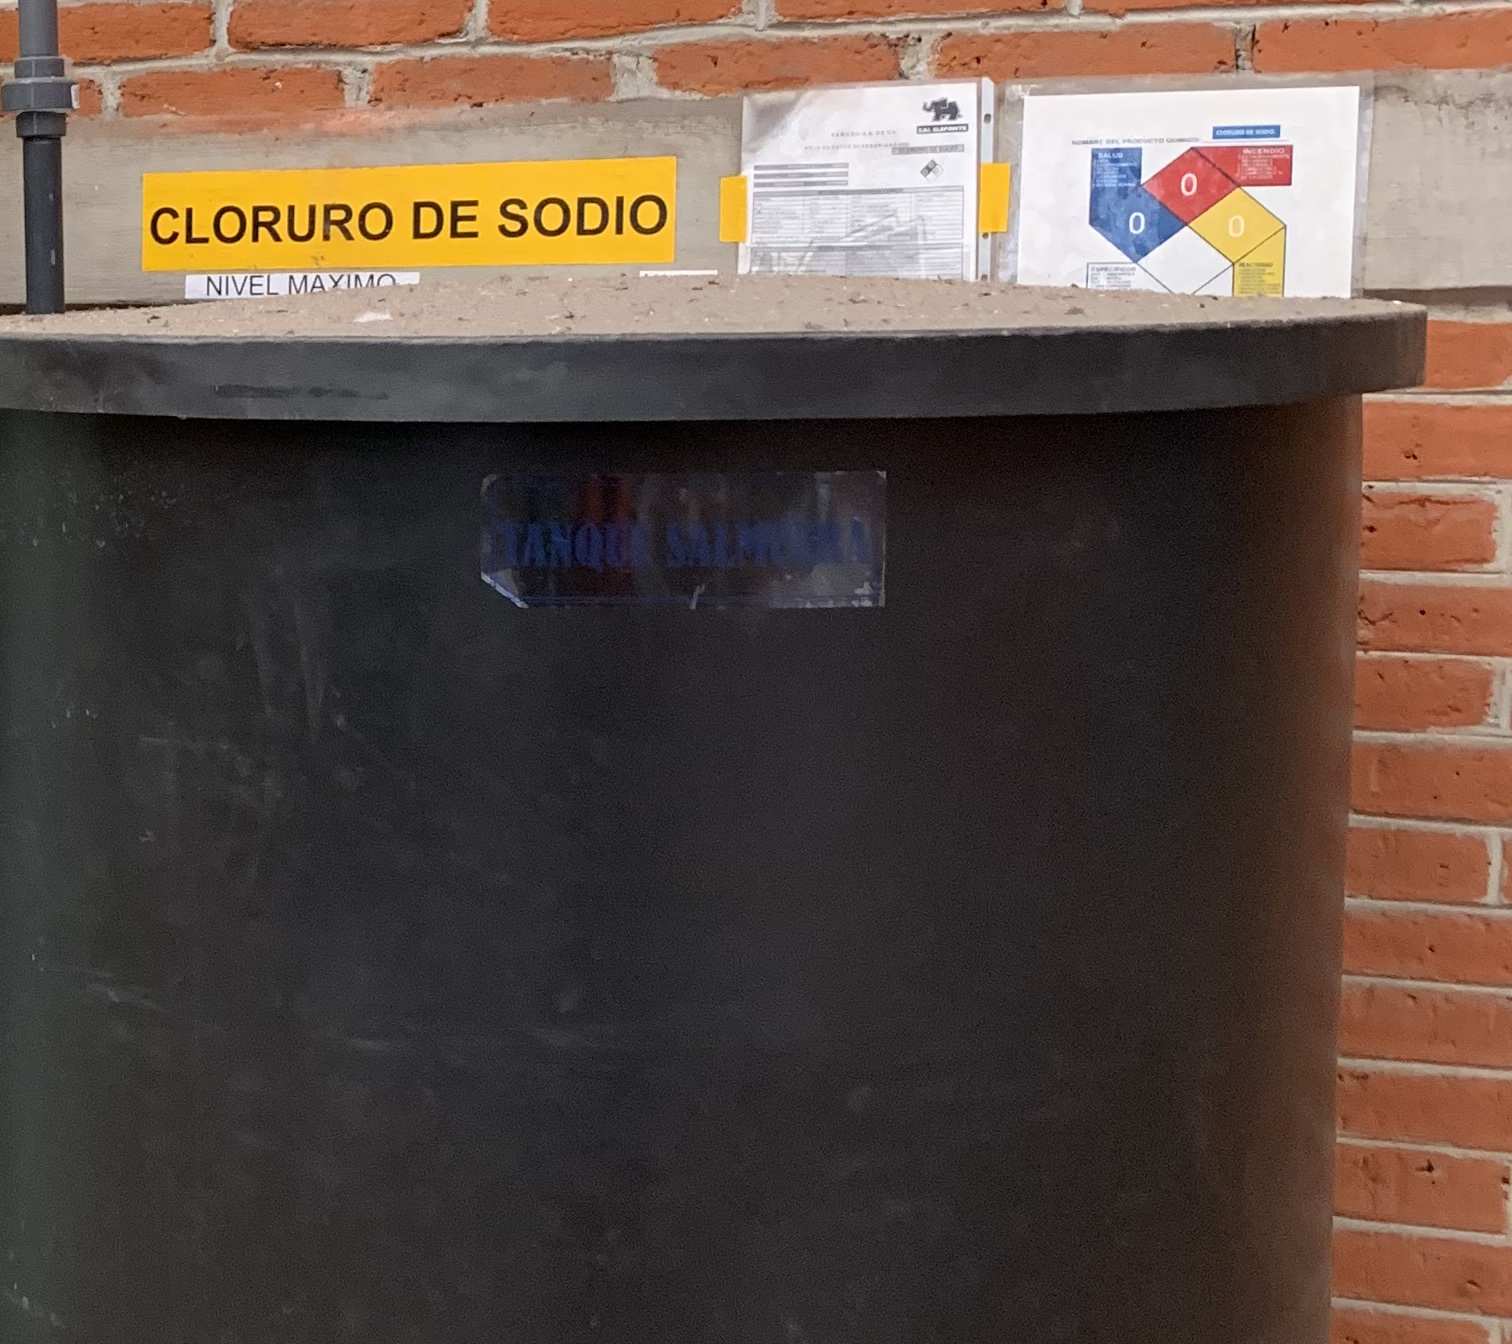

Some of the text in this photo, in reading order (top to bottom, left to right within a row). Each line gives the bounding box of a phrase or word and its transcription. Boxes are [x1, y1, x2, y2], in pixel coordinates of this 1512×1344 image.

[1180, 173, 1198, 196] 0
[149, 193, 669, 246] CLORURO DE SODIO
[1128, 211, 1146, 235] 0
[1228, 215, 1245, 238] 0
[206, 274, 280, 297] NIVEL
[500, 518, 653, 573] TANQUE
